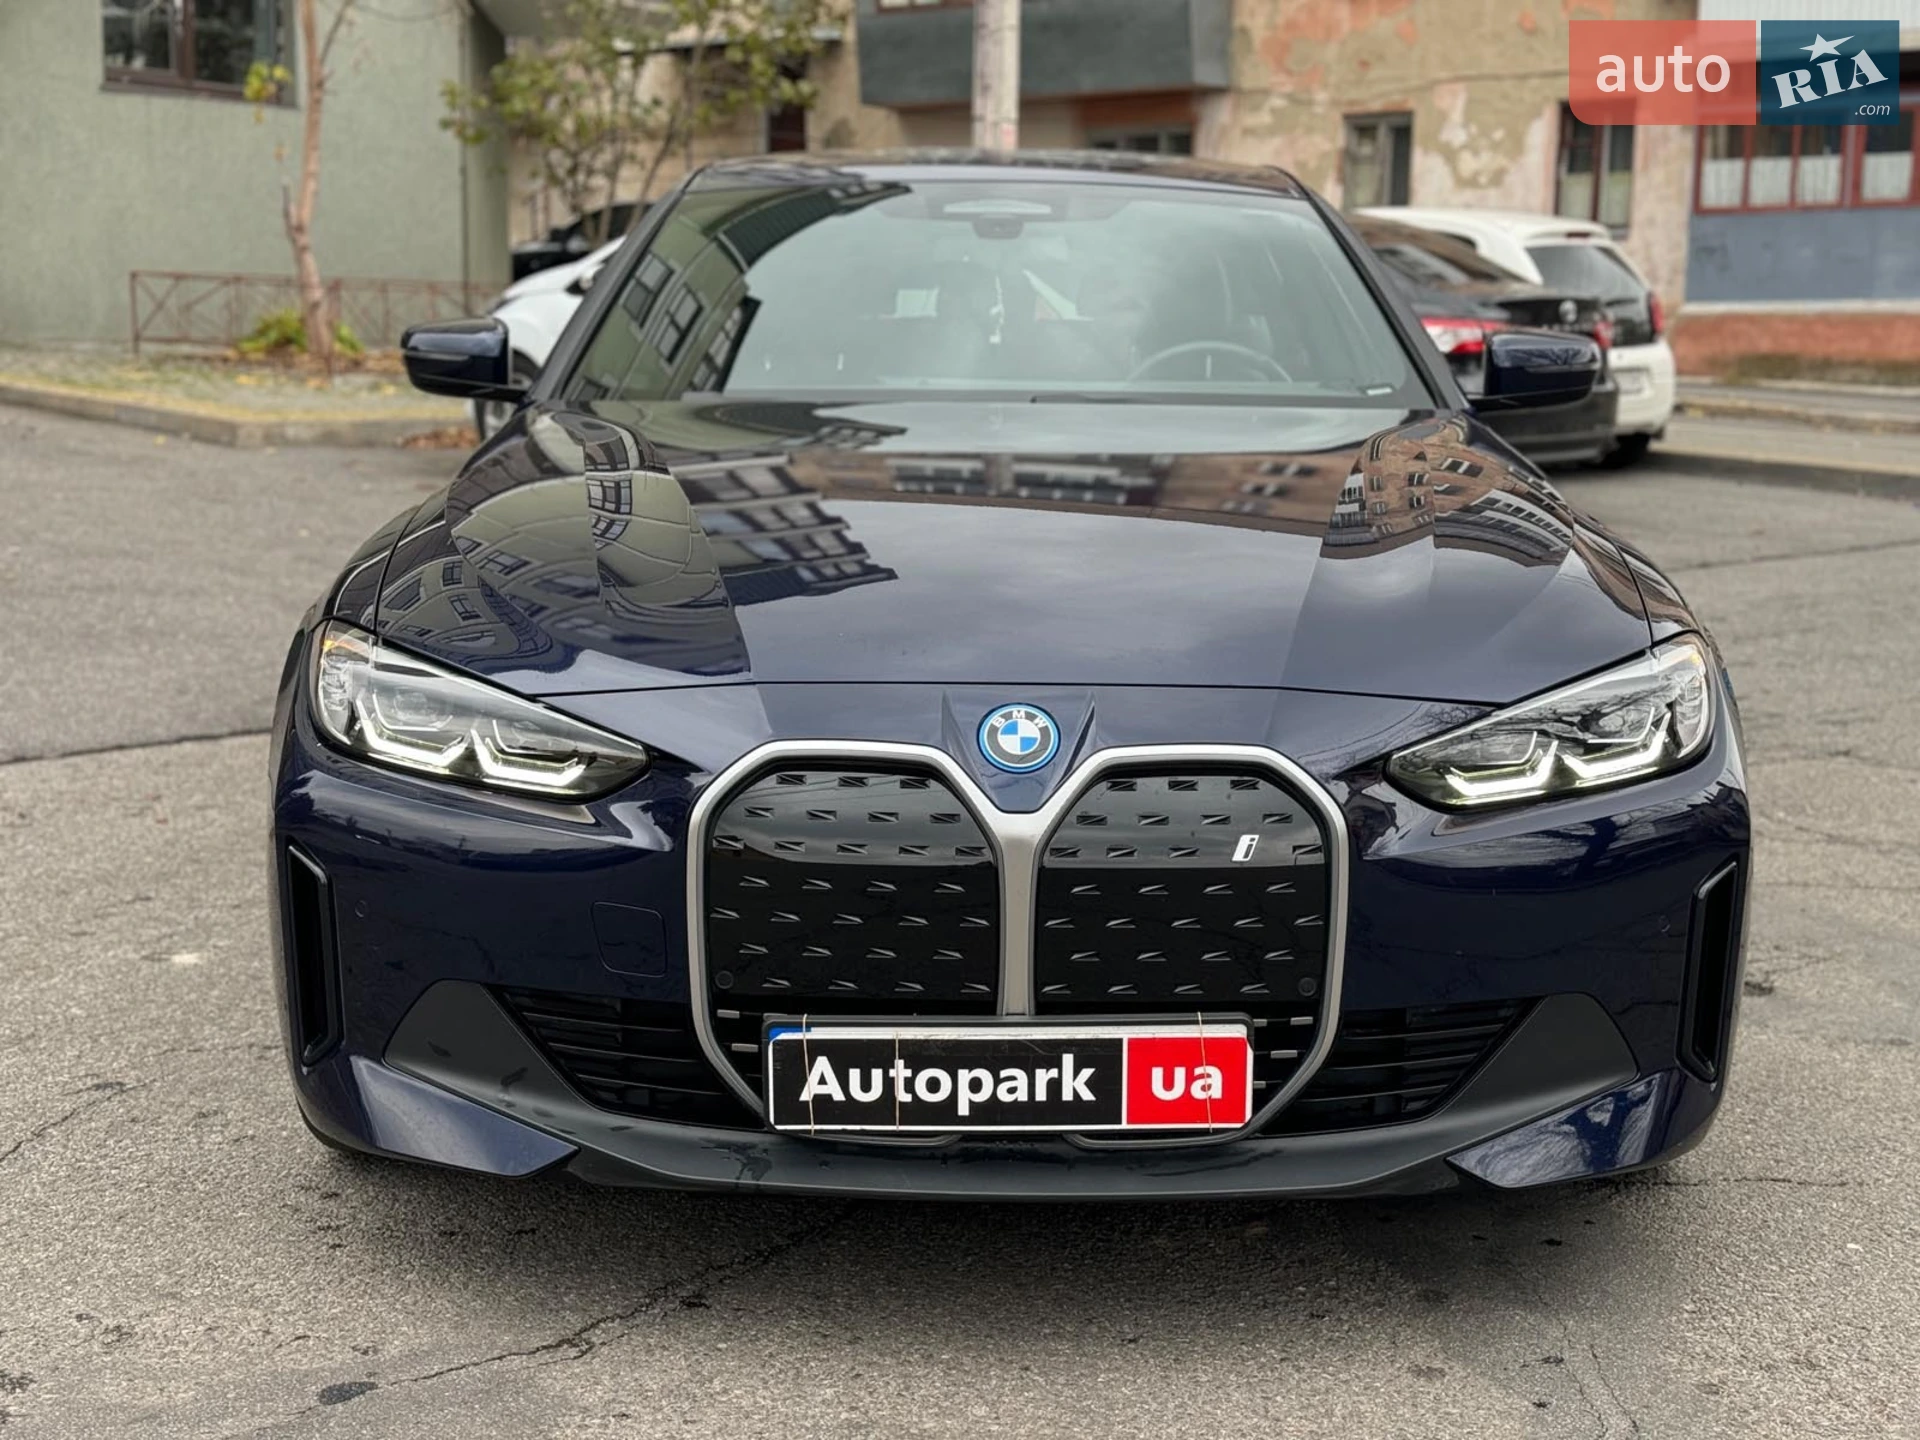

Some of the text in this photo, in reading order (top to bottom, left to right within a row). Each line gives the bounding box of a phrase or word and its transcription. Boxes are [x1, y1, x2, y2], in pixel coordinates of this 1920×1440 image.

[991, 709, 1048, 728] BMW
[798, 1053, 1223, 1117] Autopark ua
